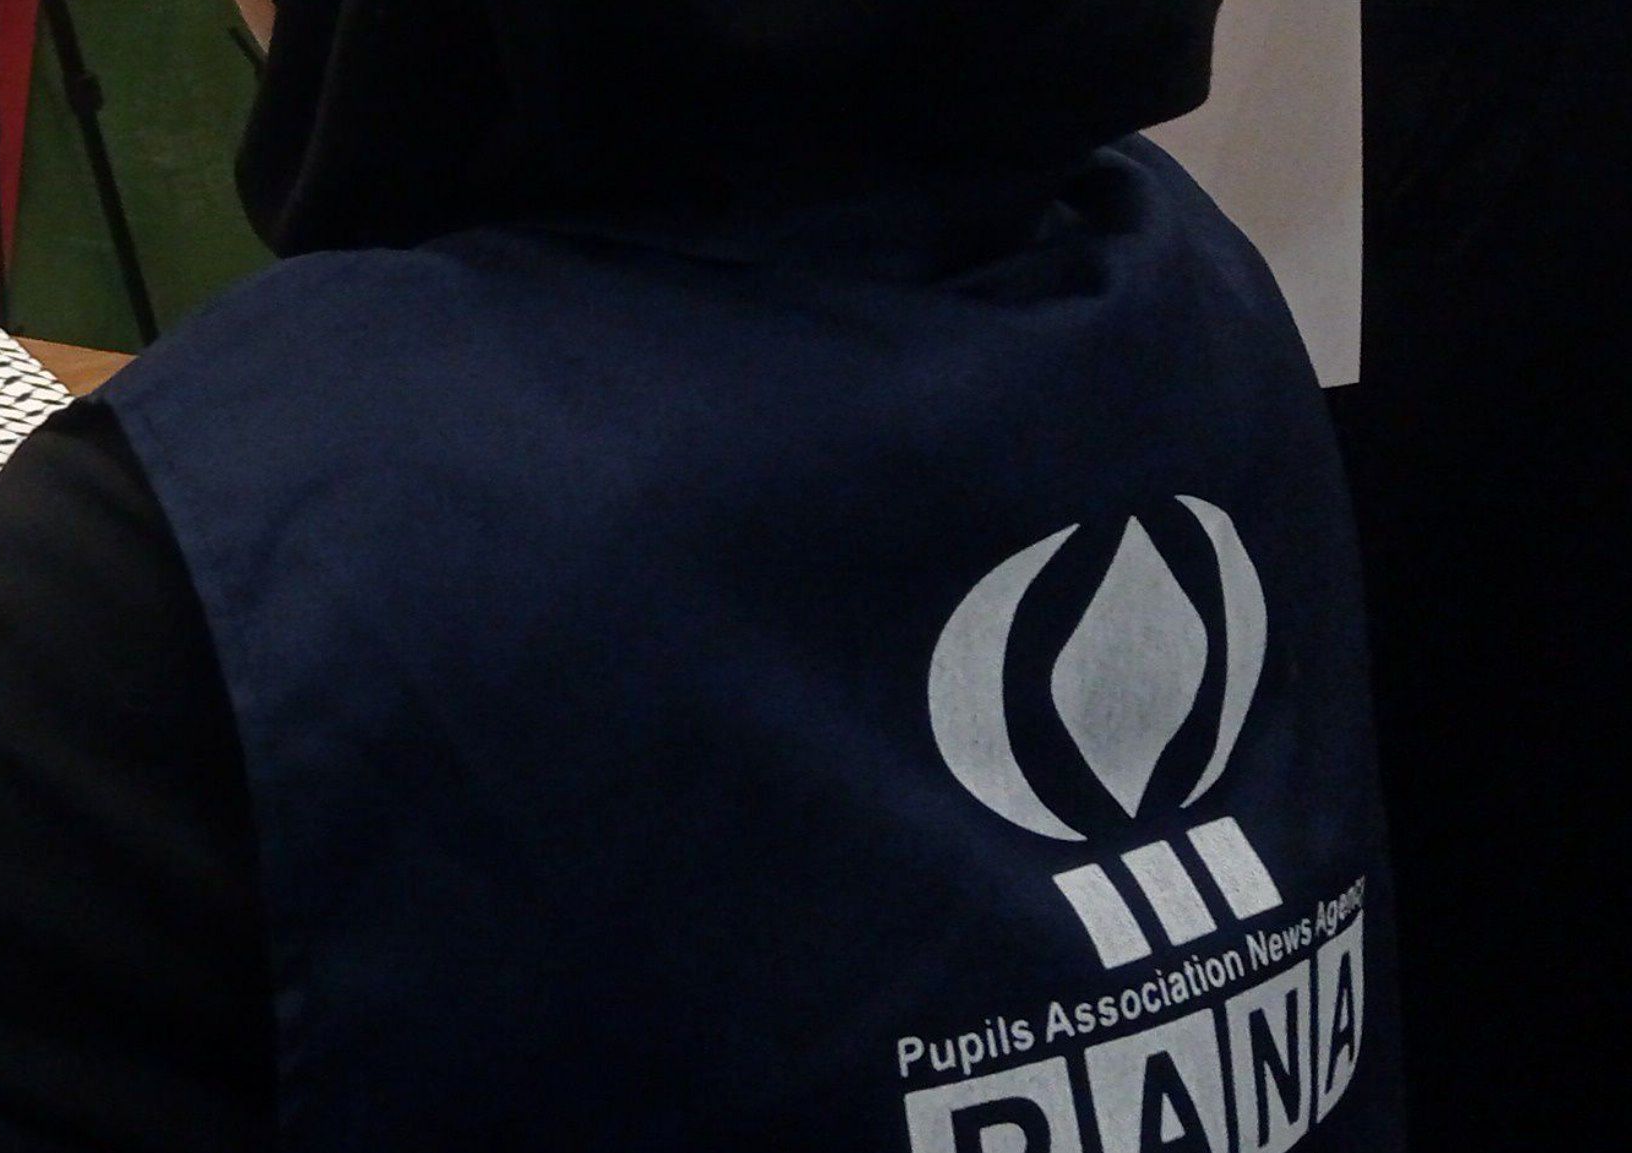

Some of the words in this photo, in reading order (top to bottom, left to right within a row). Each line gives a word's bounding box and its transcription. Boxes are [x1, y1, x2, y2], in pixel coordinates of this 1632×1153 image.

[897, 1013, 1035, 1078] Pupils
[1045, 949, 1246, 1044] Association
[1244, 917, 1313, 973] News
